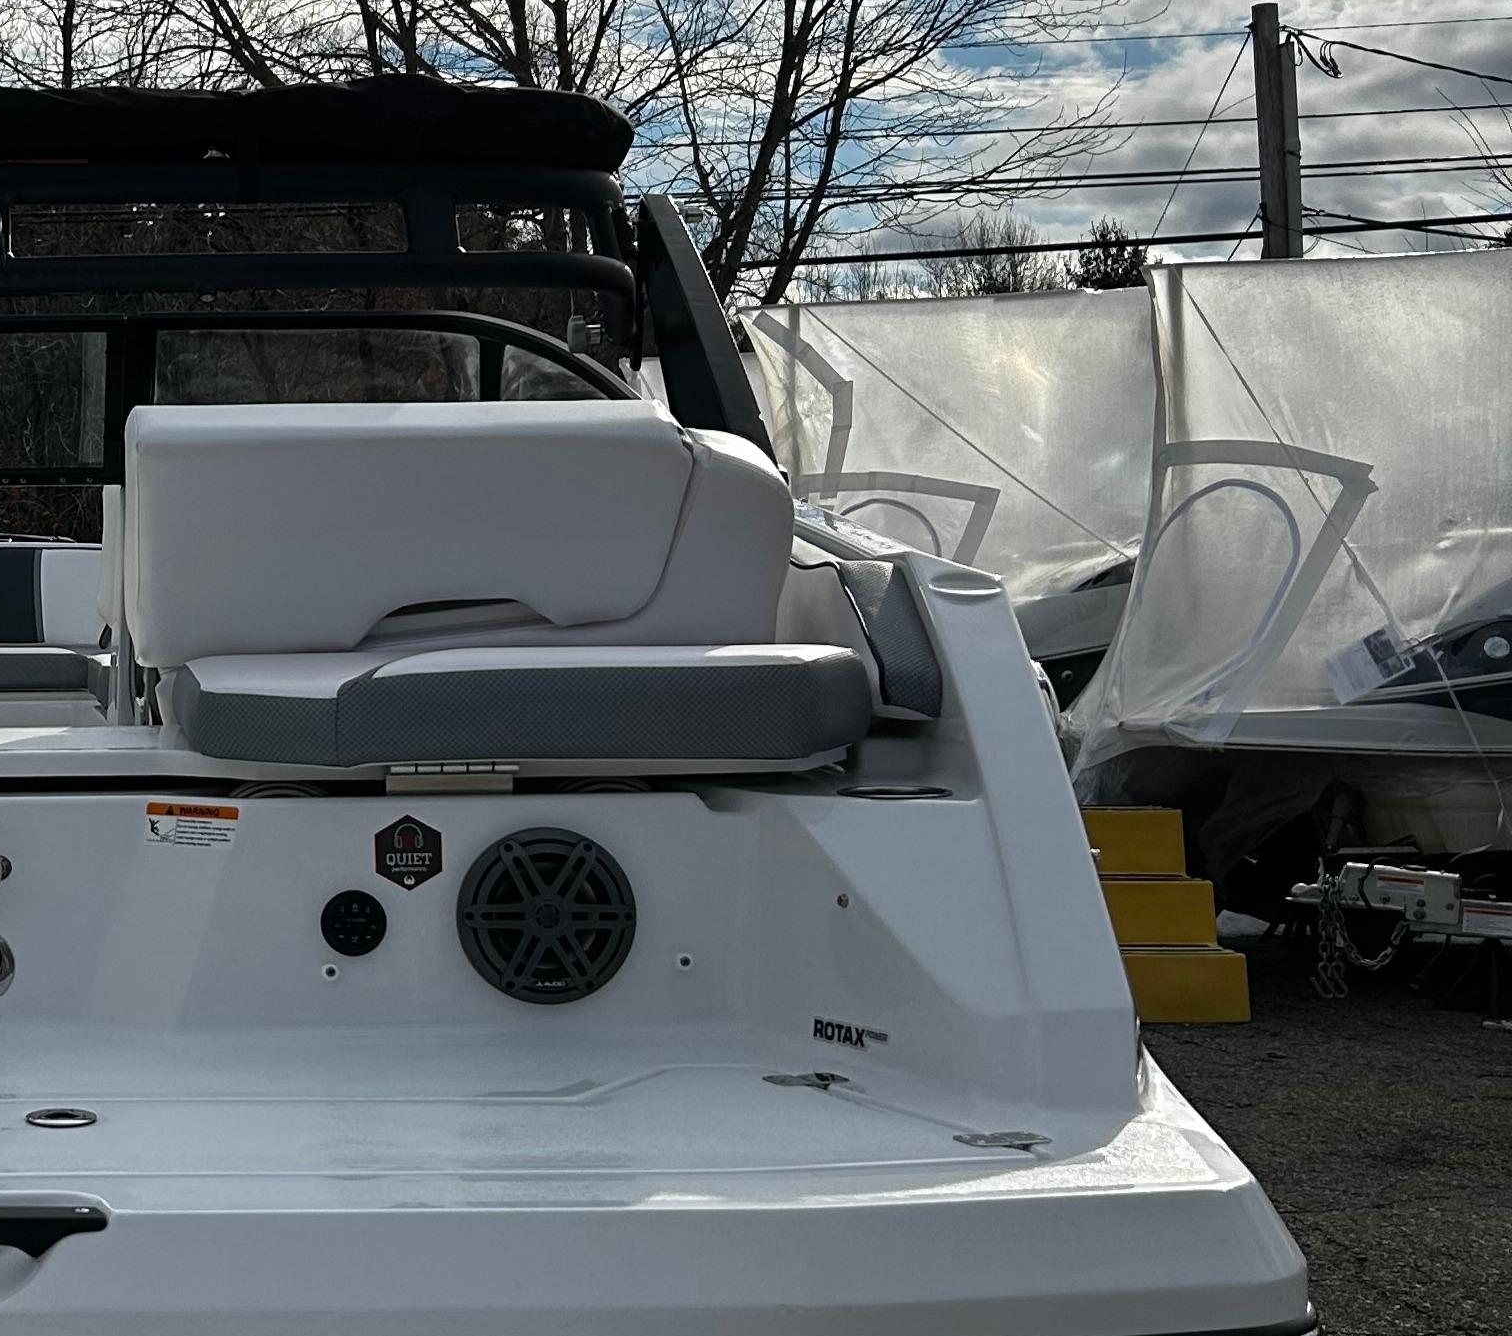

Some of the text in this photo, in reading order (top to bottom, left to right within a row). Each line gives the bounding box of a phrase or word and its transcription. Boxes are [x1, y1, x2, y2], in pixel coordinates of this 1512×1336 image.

[179, 806, 220, 817] WARNING
[386, 853, 433, 866] QUIET
[813, 1018, 865, 1048] ROTAX
